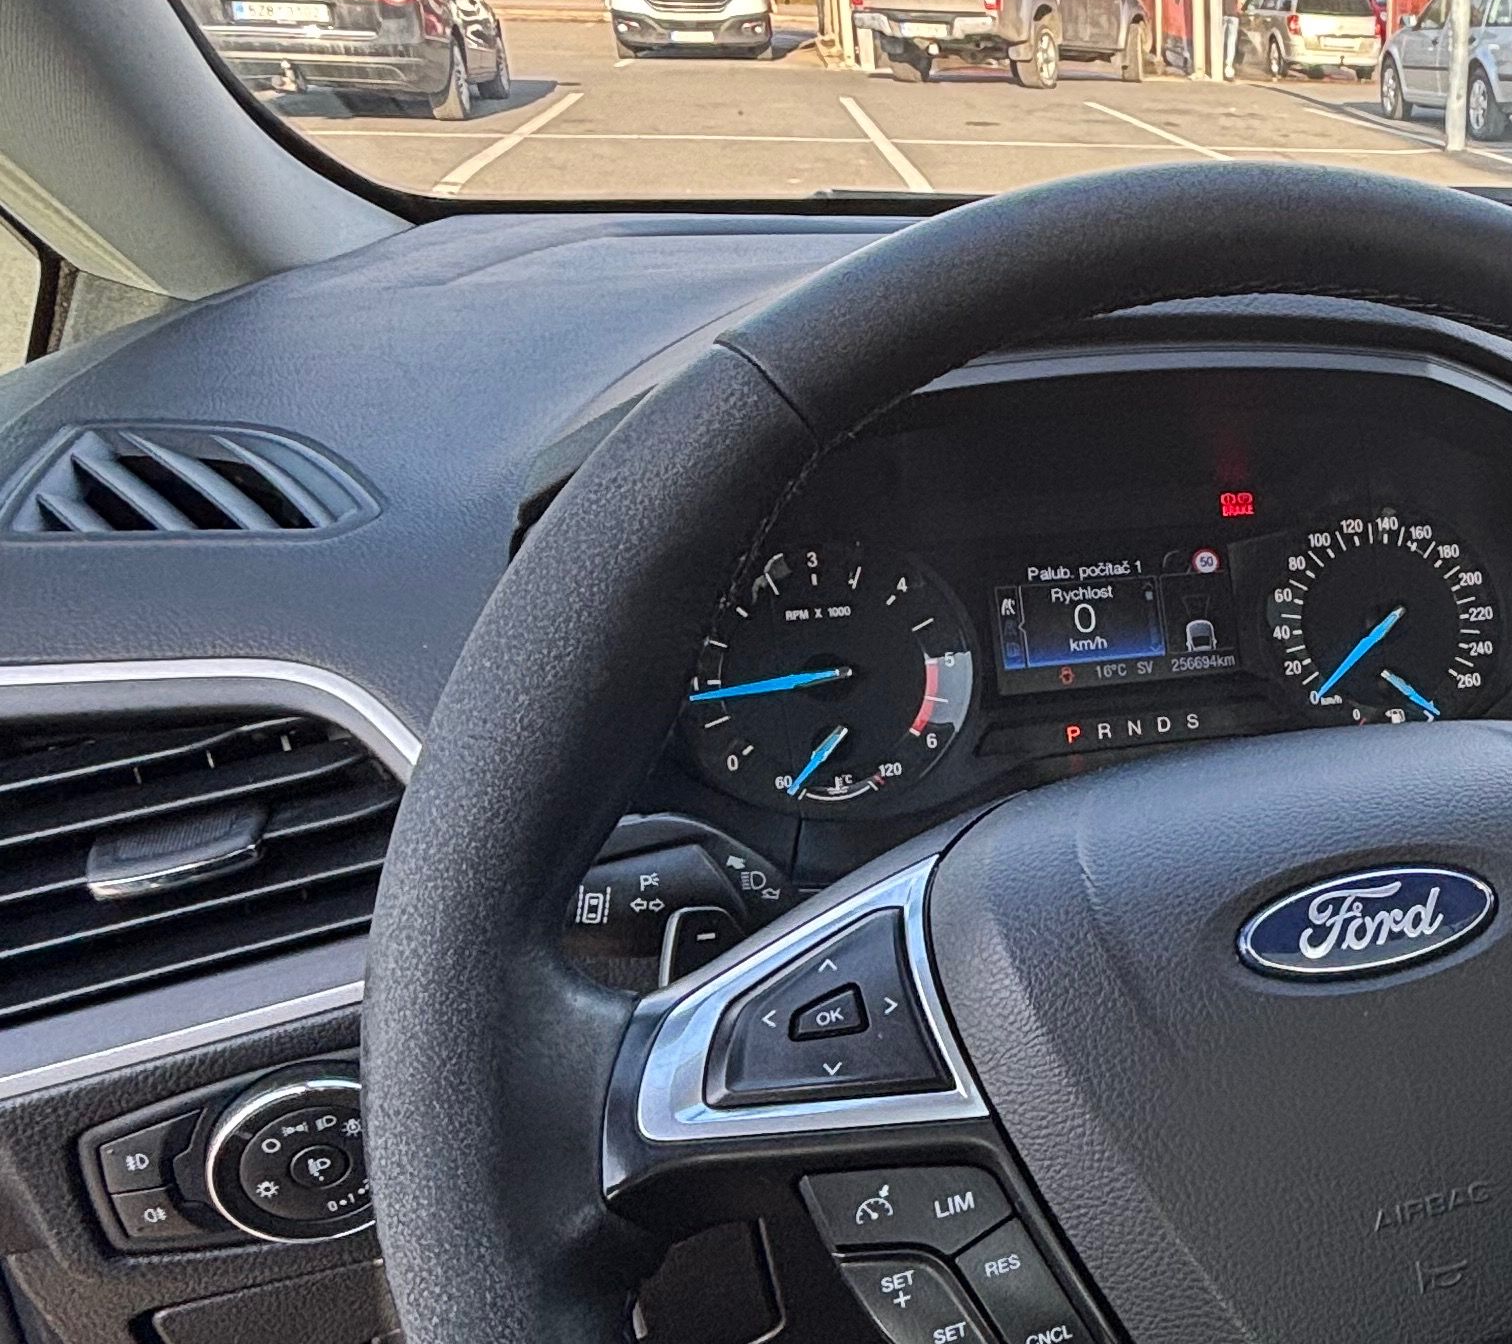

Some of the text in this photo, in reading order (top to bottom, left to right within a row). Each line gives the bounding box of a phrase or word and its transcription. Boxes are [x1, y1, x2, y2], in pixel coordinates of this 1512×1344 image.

[1340, 518, 1363, 534] 120
[1375, 516, 1398, 531] 140
[1308, 533, 1331, 547] 100
[1409, 525, 1432, 540] 160
[1437, 544, 1460, 559] 180
[807, 552, 818, 568] 3
[1200, 556, 1214, 567] 50
[1288, 556, 1306, 571] 80
[1027, 566, 1075, 581] Palub.
[1079, 560, 1131, 581] počítač
[1458, 571, 1482, 586] 200
[896, 577, 908, 593] 4
[1051, 584, 1114, 605] Rychlost
[1274, 588, 1293, 603] 60
[785, 609, 809, 621] RPM
[827, 606, 851, 618] 1000
[1074, 604, 1096, 633] 0
[1469, 606, 1493, 621] 220
[1273, 625, 1291, 640] 40
[1070, 636, 1107, 652] km/h
[1469, 641, 1493, 656] 240
[945, 651, 955, 667] 5
[1096, 663, 1127, 678] 16°C
[1137, 661, 1154, 674] SV
[1284, 661, 1301, 676] 20
[1457, 672, 1481, 689] 260
[1066, 713, 1200, 743] P R N D S
[926, 733, 938, 748] 6
[727, 755, 738, 771] 0
[879, 762, 902, 777] 120
[775, 775, 793, 789] 60
[1300, 880, 1444, 960] Ford
[816, 1006, 844, 1027] OK
[934, 1191, 976, 1219] LIM
[984, 1253, 1022, 1278] RES
[880, 1269, 915, 1293] SET
